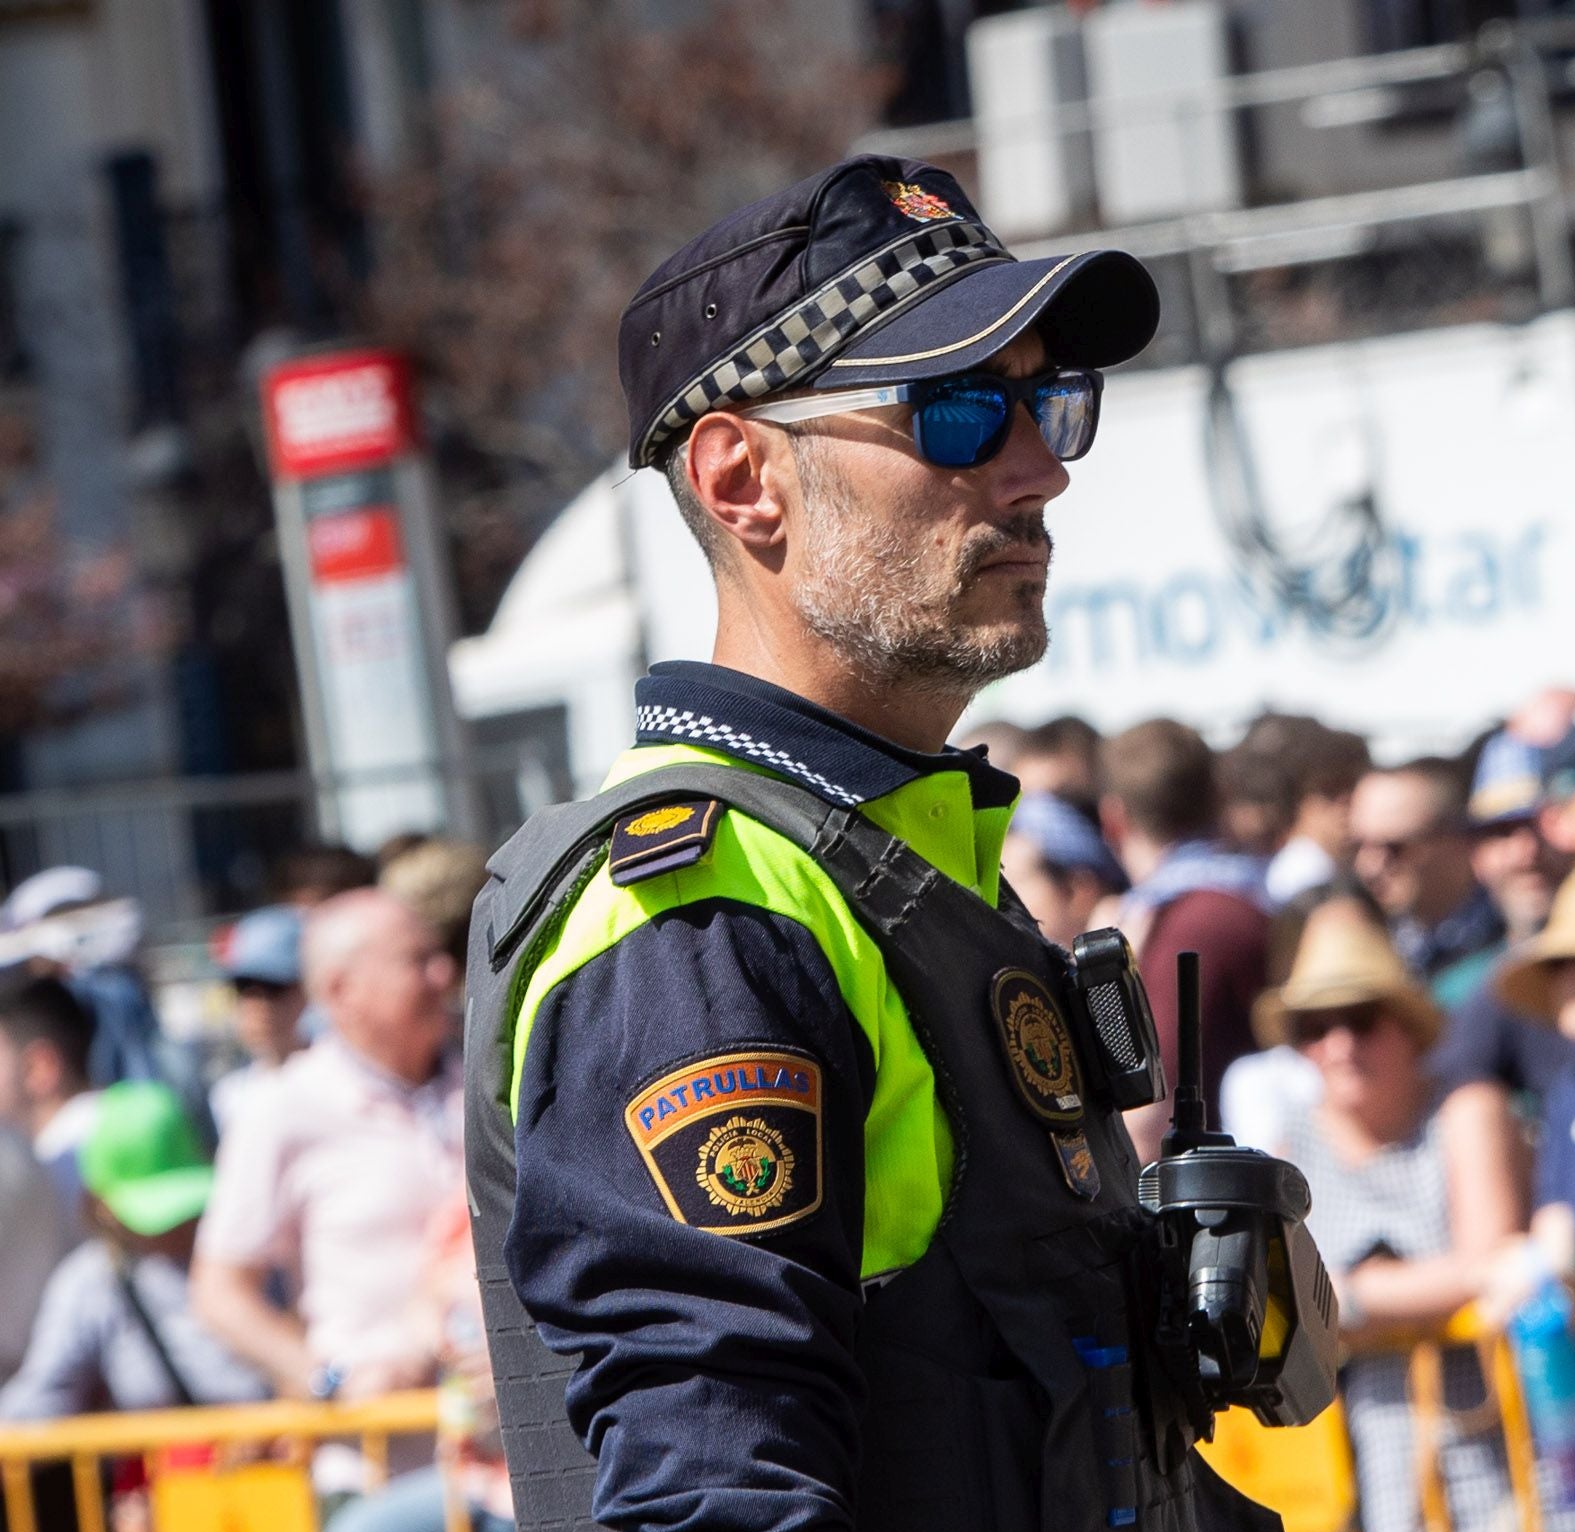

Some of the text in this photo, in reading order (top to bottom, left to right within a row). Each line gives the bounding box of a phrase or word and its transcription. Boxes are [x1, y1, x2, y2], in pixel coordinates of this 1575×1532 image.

[1046, 522, 1548, 672] movtar
[638, 1067, 810, 1131] PATRULLAS
[746, 1128, 773, 1144] LOCAL
